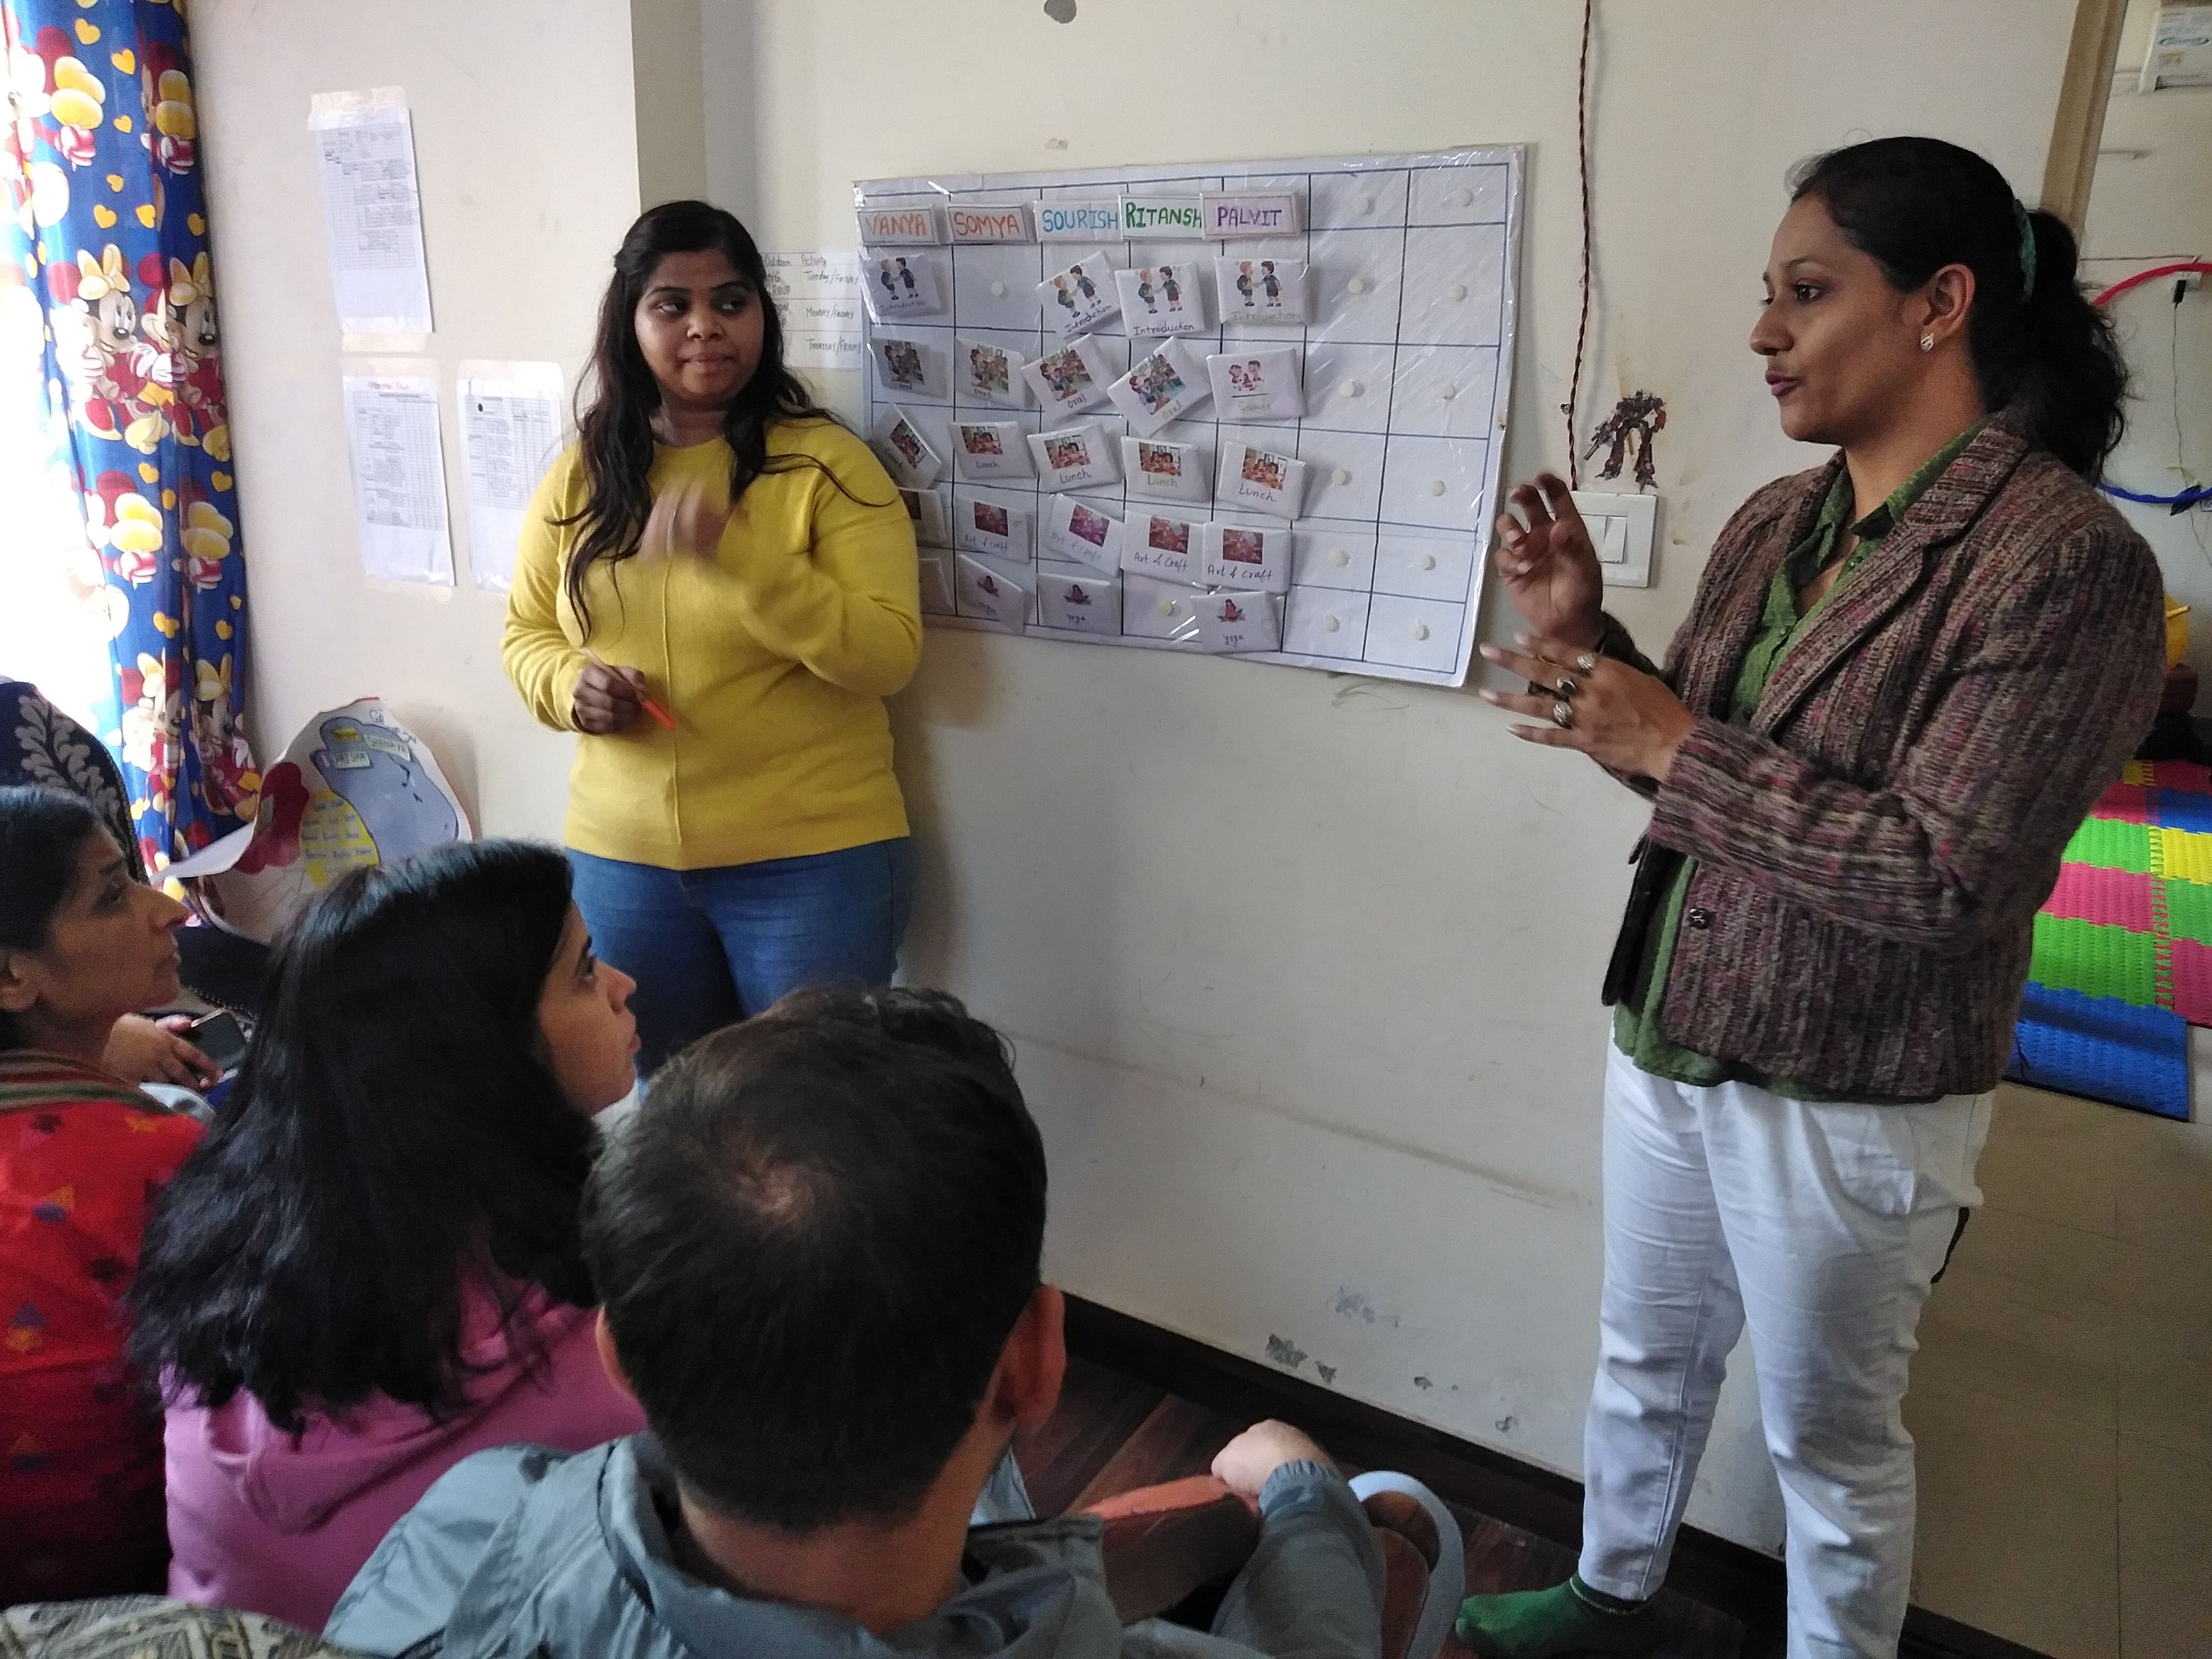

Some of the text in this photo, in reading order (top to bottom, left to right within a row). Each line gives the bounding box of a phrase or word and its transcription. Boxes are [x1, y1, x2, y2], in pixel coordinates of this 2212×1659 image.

[865, 214, 927, 236] VANYA
[954, 211, 1020, 239] SOMYA
[1042, 209, 1118, 233] SOURISH
[1125, 202, 1202, 229] RITANSH
[1217, 206, 1283, 228] PALVIT
[1064, 304, 1112, 333] Introduction
[1133, 321, 1195, 336] Introduction
[1059, 468, 1092, 484] Lunch
[1148, 474, 1177, 487] Lunch
[1238, 483, 1277, 502] Lunch
[1134, 551, 1149, 563] Art
[1208, 565, 1225, 576] Art
